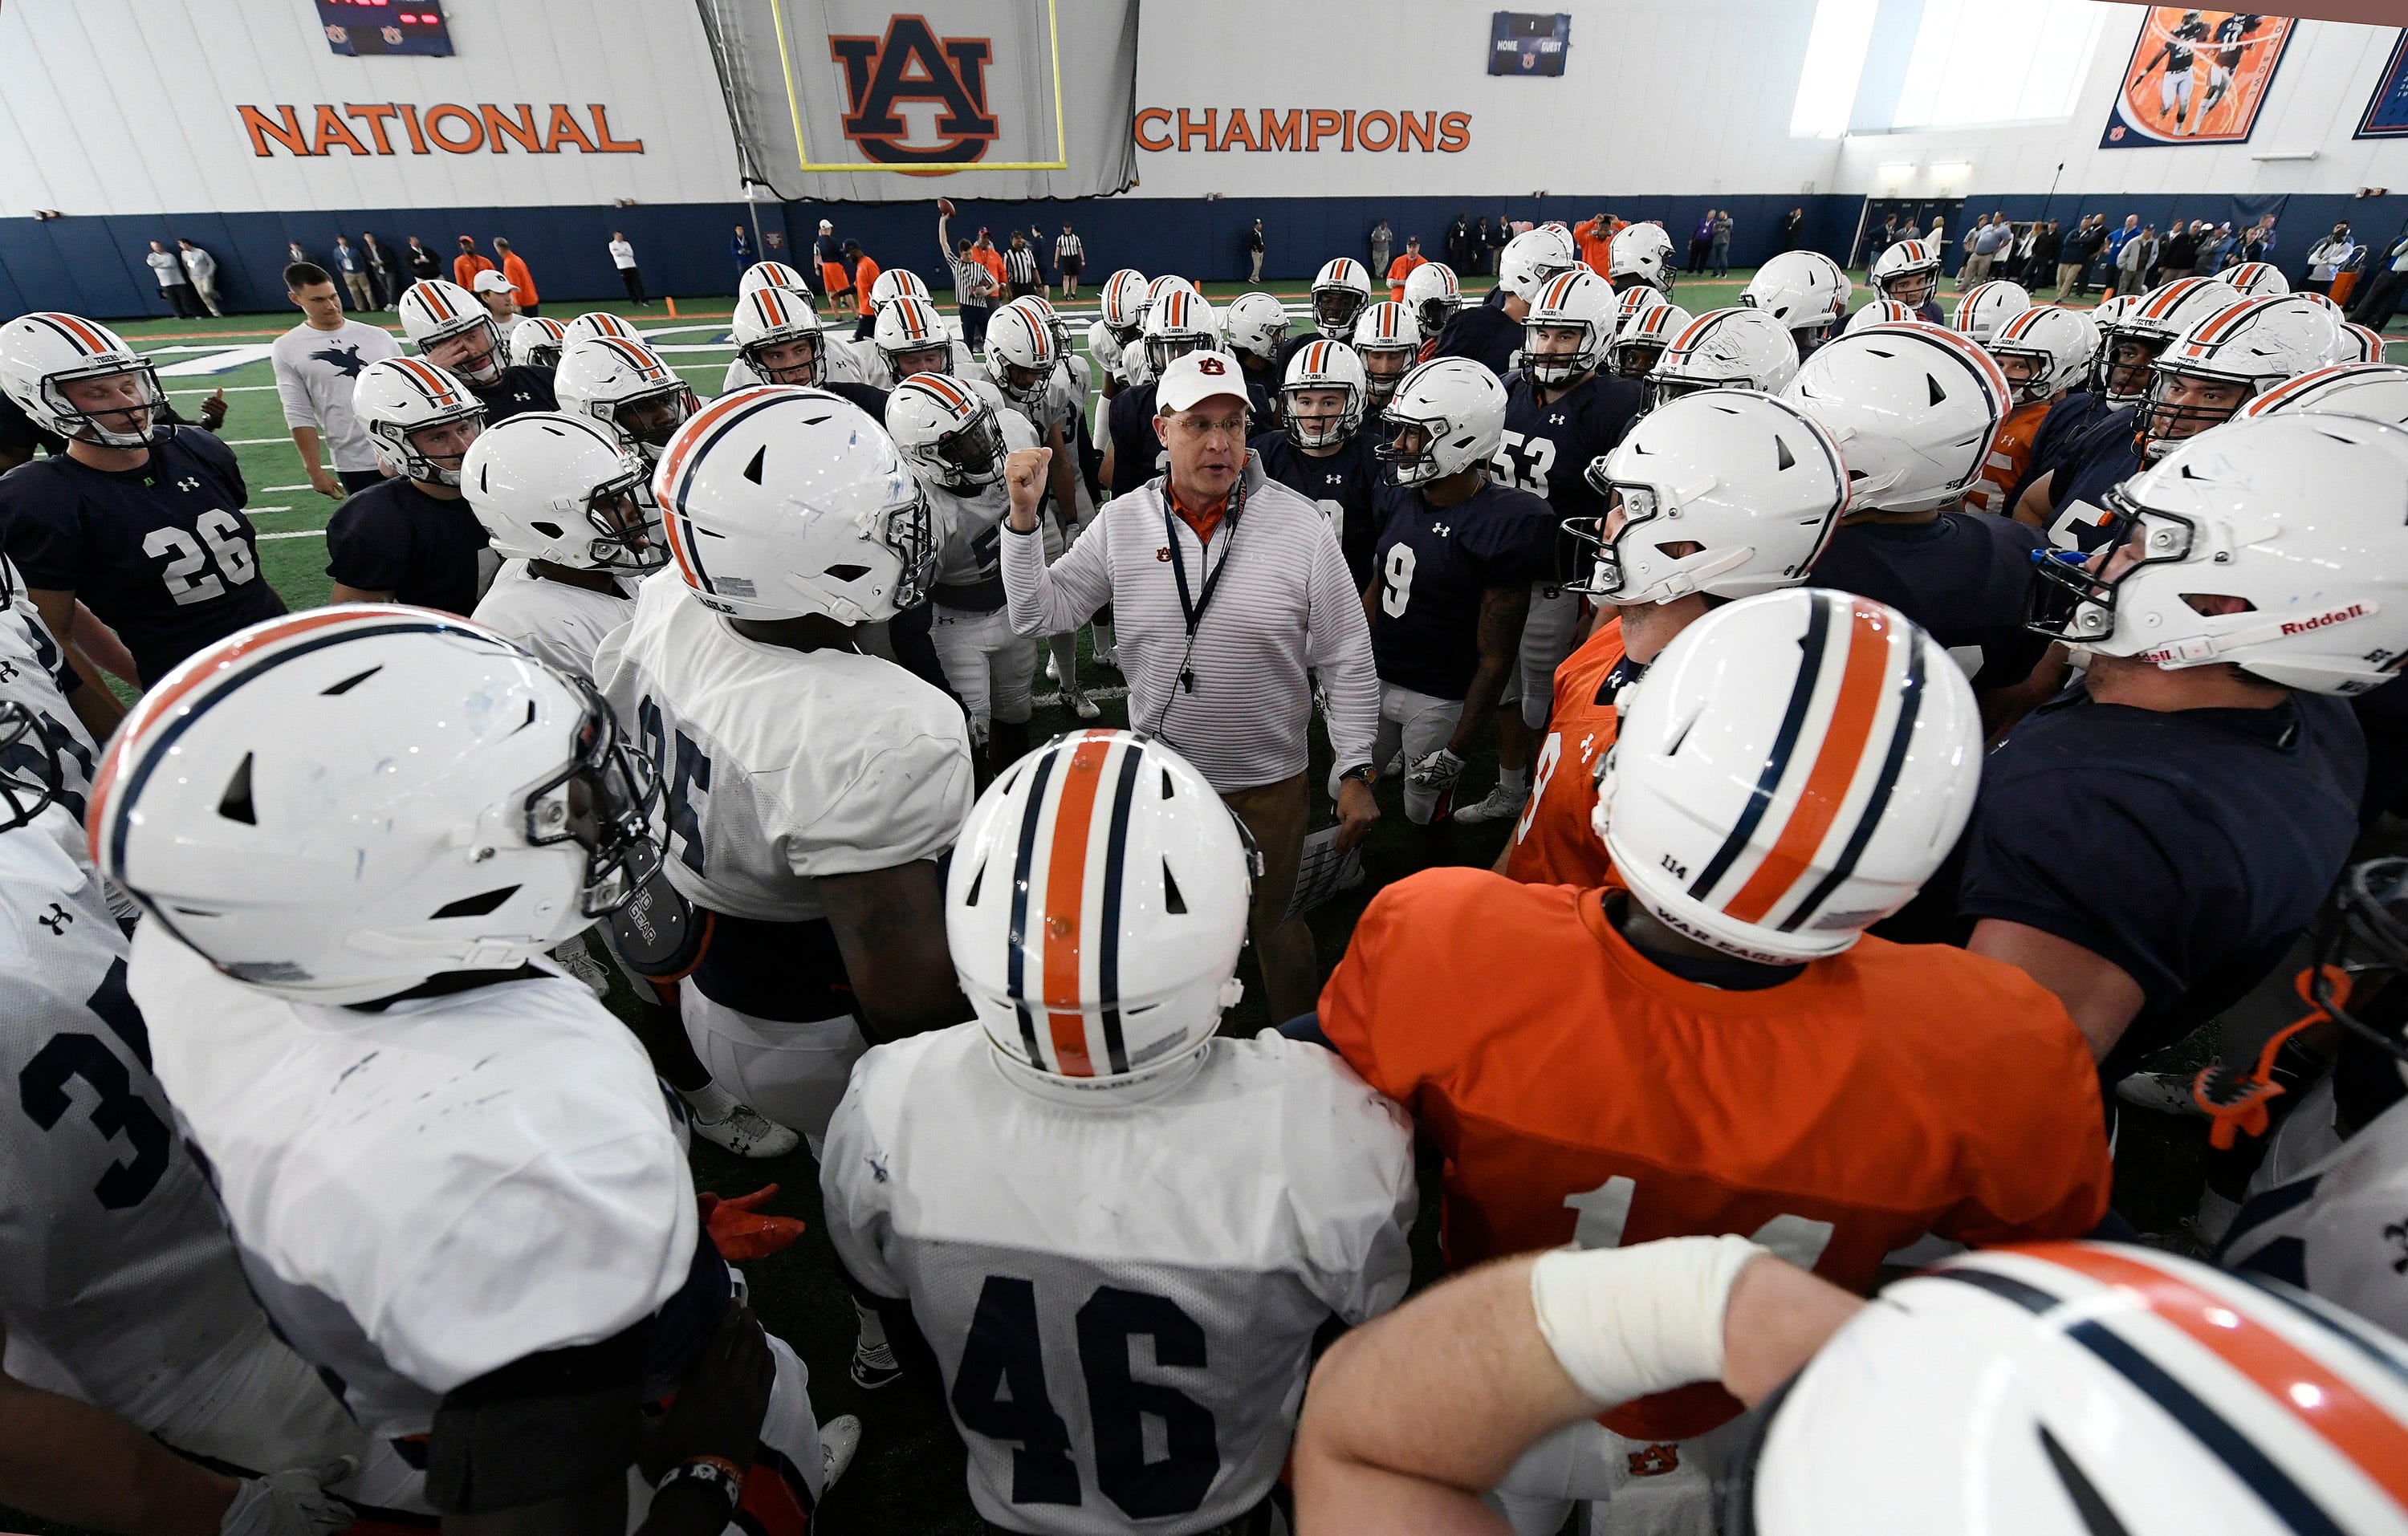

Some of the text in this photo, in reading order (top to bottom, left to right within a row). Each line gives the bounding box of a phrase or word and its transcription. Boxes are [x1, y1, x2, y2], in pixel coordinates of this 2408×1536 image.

[1497, 39, 1563, 52] HOME GUEST
[2248, 56, 2271, 96] BOWL
[236, 102, 644, 157] NATIONAL
[1134, 107, 1472, 152] CHAMPIONS
[94, 355, 120, 364] TIGERS
[651, 377, 669, 387] TIGERS
[442, 403, 463, 413] TIGERS
[1491, 429, 1556, 499] 53
[2148, 446, 2167, 455] AUBURN
[141, 508, 255, 606] 26
[1382, 542, 1416, 618] 9
[2280, 603, 2365, 636] Riddell
[1661, 853, 1688, 880] 114
[628, 900, 657, 947] GEAR
[1656, 905, 1710, 941] WAR
[951, 1275, 1221, 1519] 46
